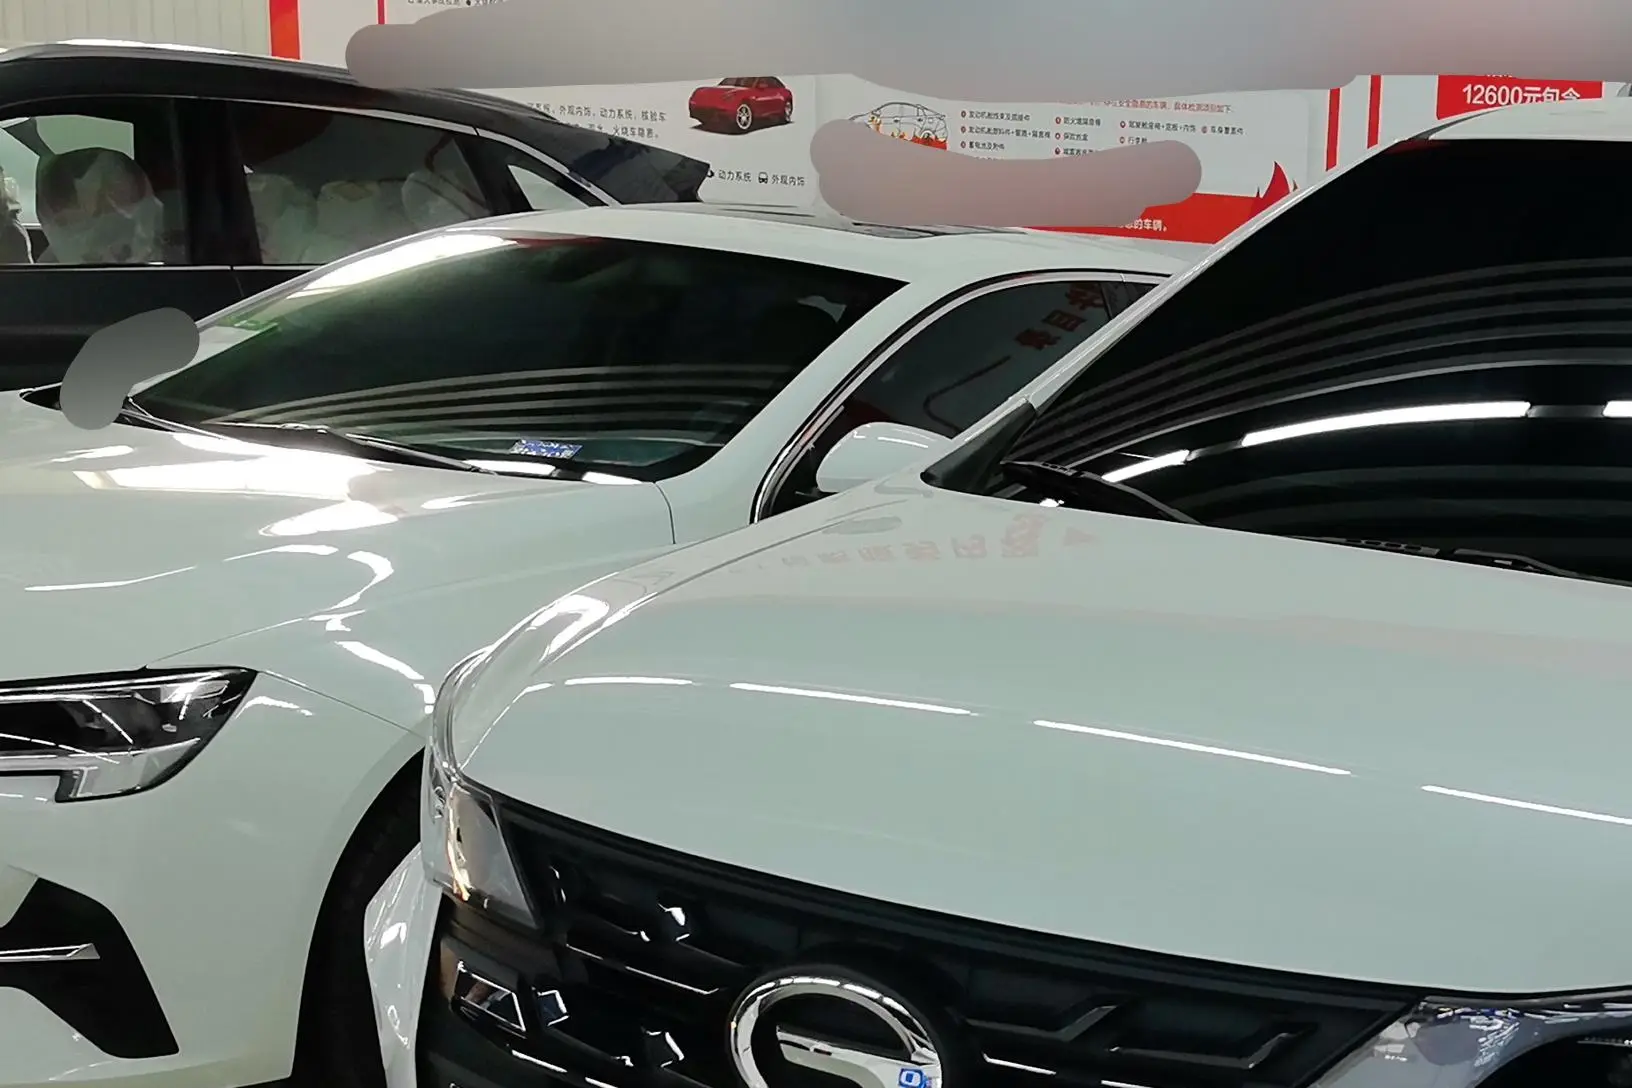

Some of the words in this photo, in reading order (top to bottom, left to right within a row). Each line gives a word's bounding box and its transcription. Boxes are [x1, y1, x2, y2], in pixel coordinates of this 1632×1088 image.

[718, 169, 752, 183] 动力系统
[771, 174, 805, 187] 外观内饰
